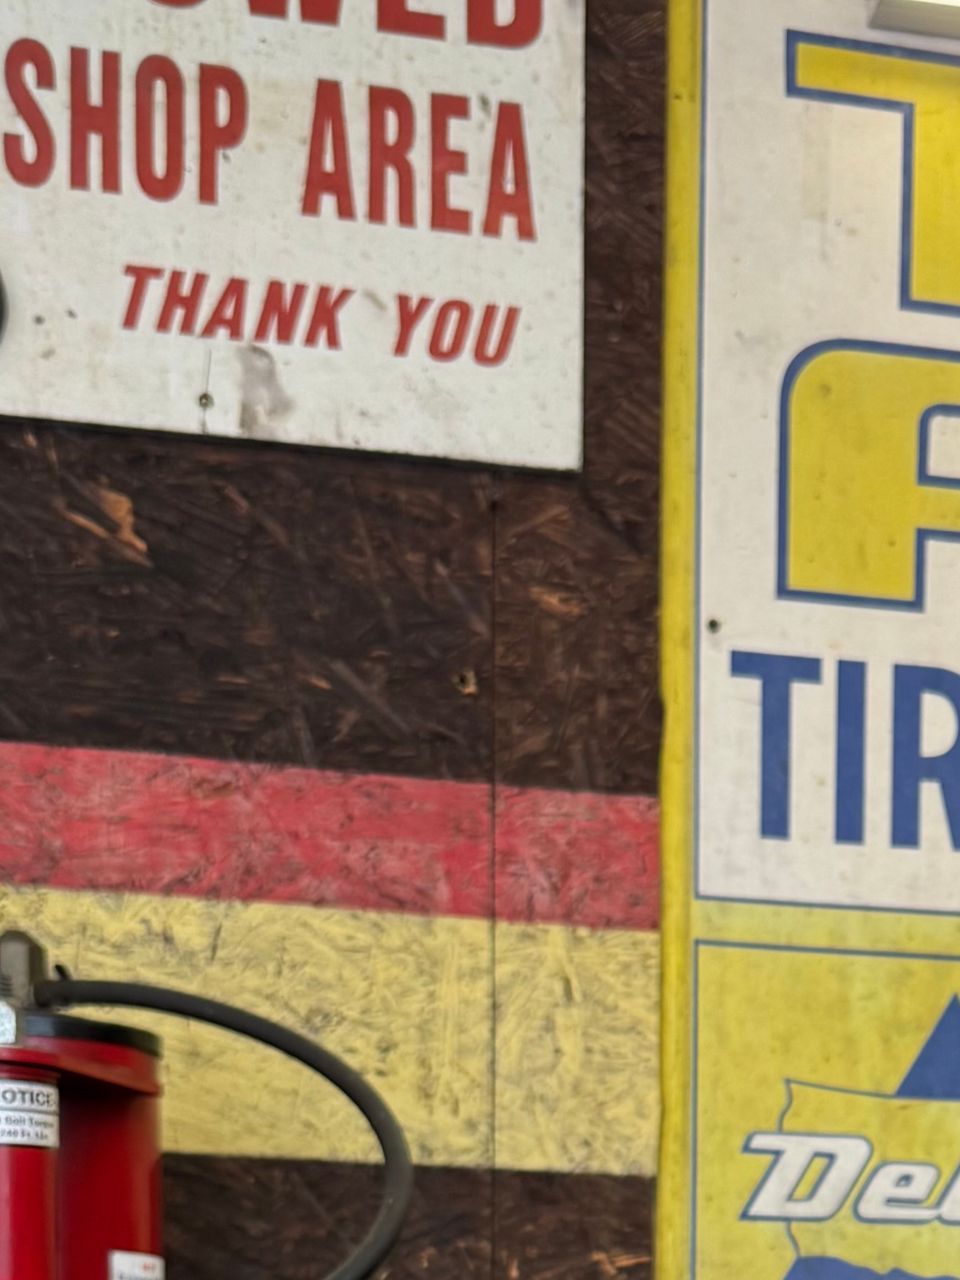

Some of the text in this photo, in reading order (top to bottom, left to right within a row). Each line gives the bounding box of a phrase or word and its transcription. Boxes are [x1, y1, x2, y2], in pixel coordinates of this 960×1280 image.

[3, 37, 537, 242] SHOP AREA
[122, 264, 522, 367] THANK YOU
